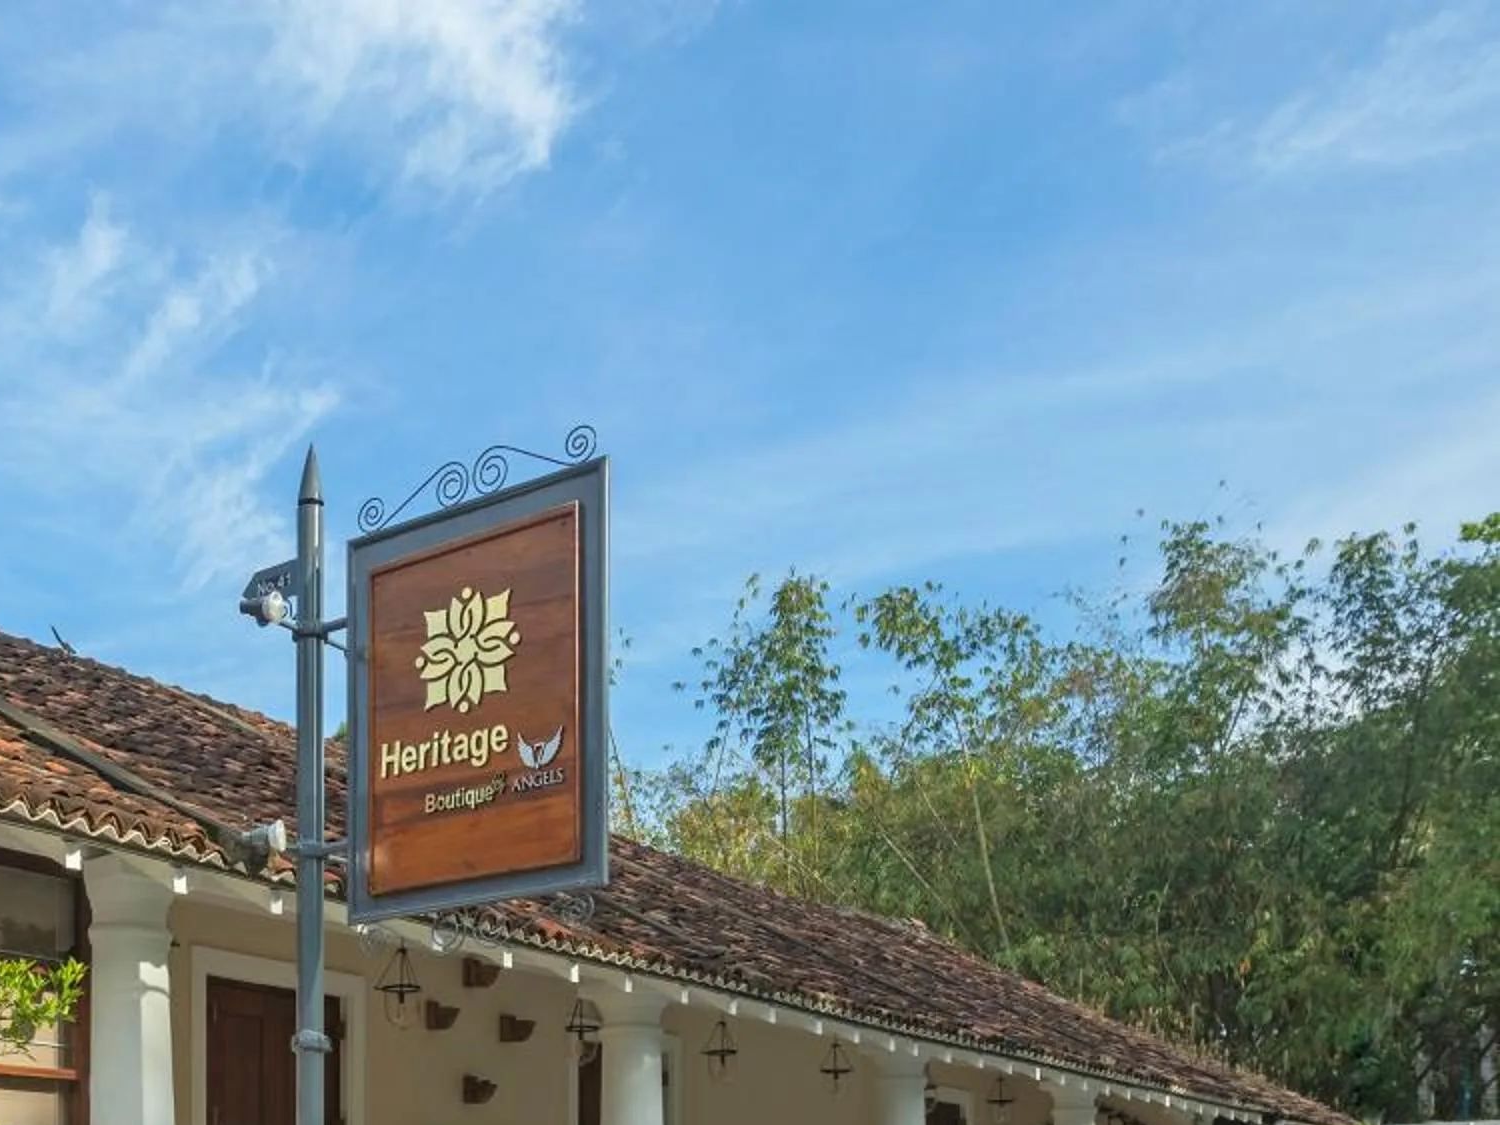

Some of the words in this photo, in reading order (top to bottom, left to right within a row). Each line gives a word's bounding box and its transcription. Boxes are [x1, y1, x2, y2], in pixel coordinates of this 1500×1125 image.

[380, 723, 509, 779] Heritage
[424, 784, 494, 814] Boutique
[512, 767, 565, 793] ANGELS
